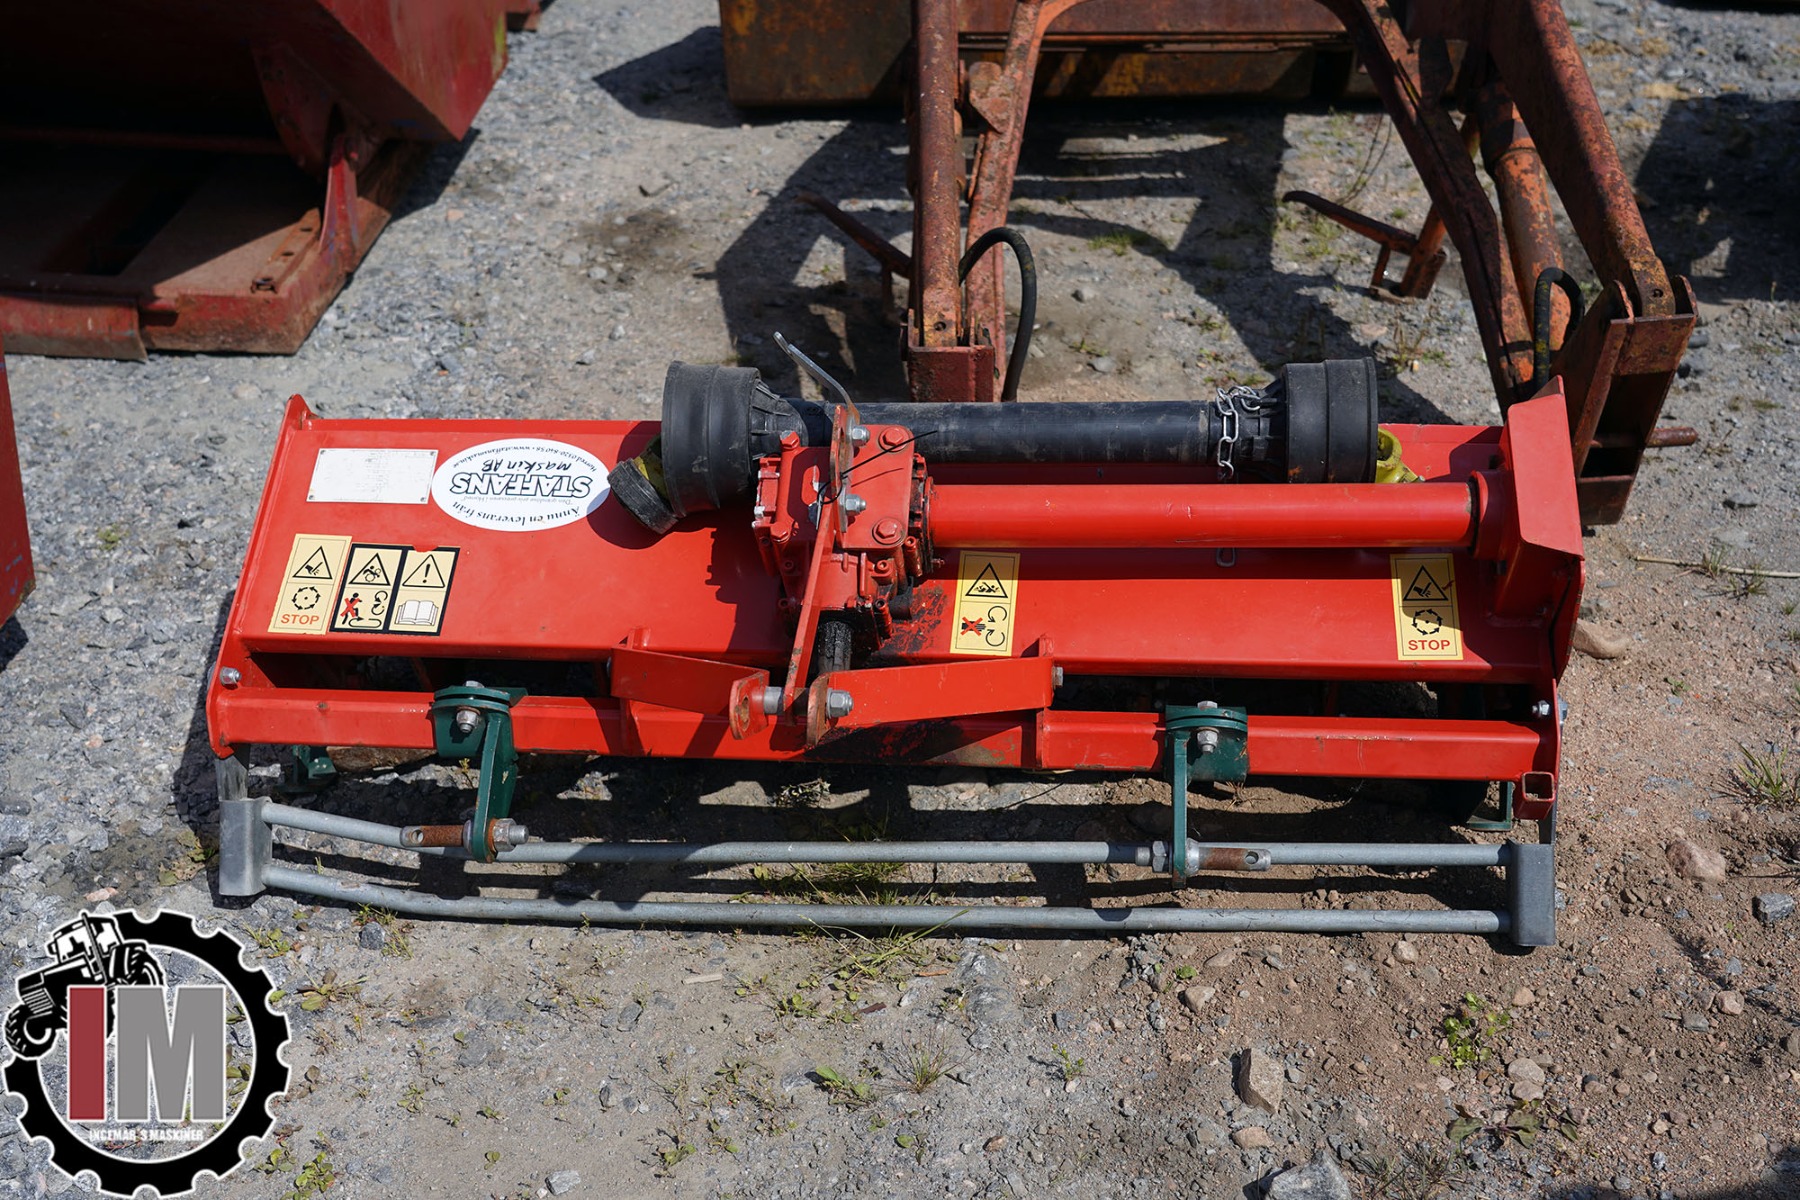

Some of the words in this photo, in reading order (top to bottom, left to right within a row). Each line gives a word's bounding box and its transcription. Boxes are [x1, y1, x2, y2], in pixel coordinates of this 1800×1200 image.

[481, 458, 504, 473] AB
[506, 460, 573, 474] maskin
[449, 471, 594, 499] STAFFANS
[452, 500, 476, 518] från
[546, 505, 580, 521] Ännu
[476, 510, 526, 526] leverans
[529, 514, 544, 523] en
[280, 613, 320, 625] STOP
[1408, 639, 1451, 651] STOP
